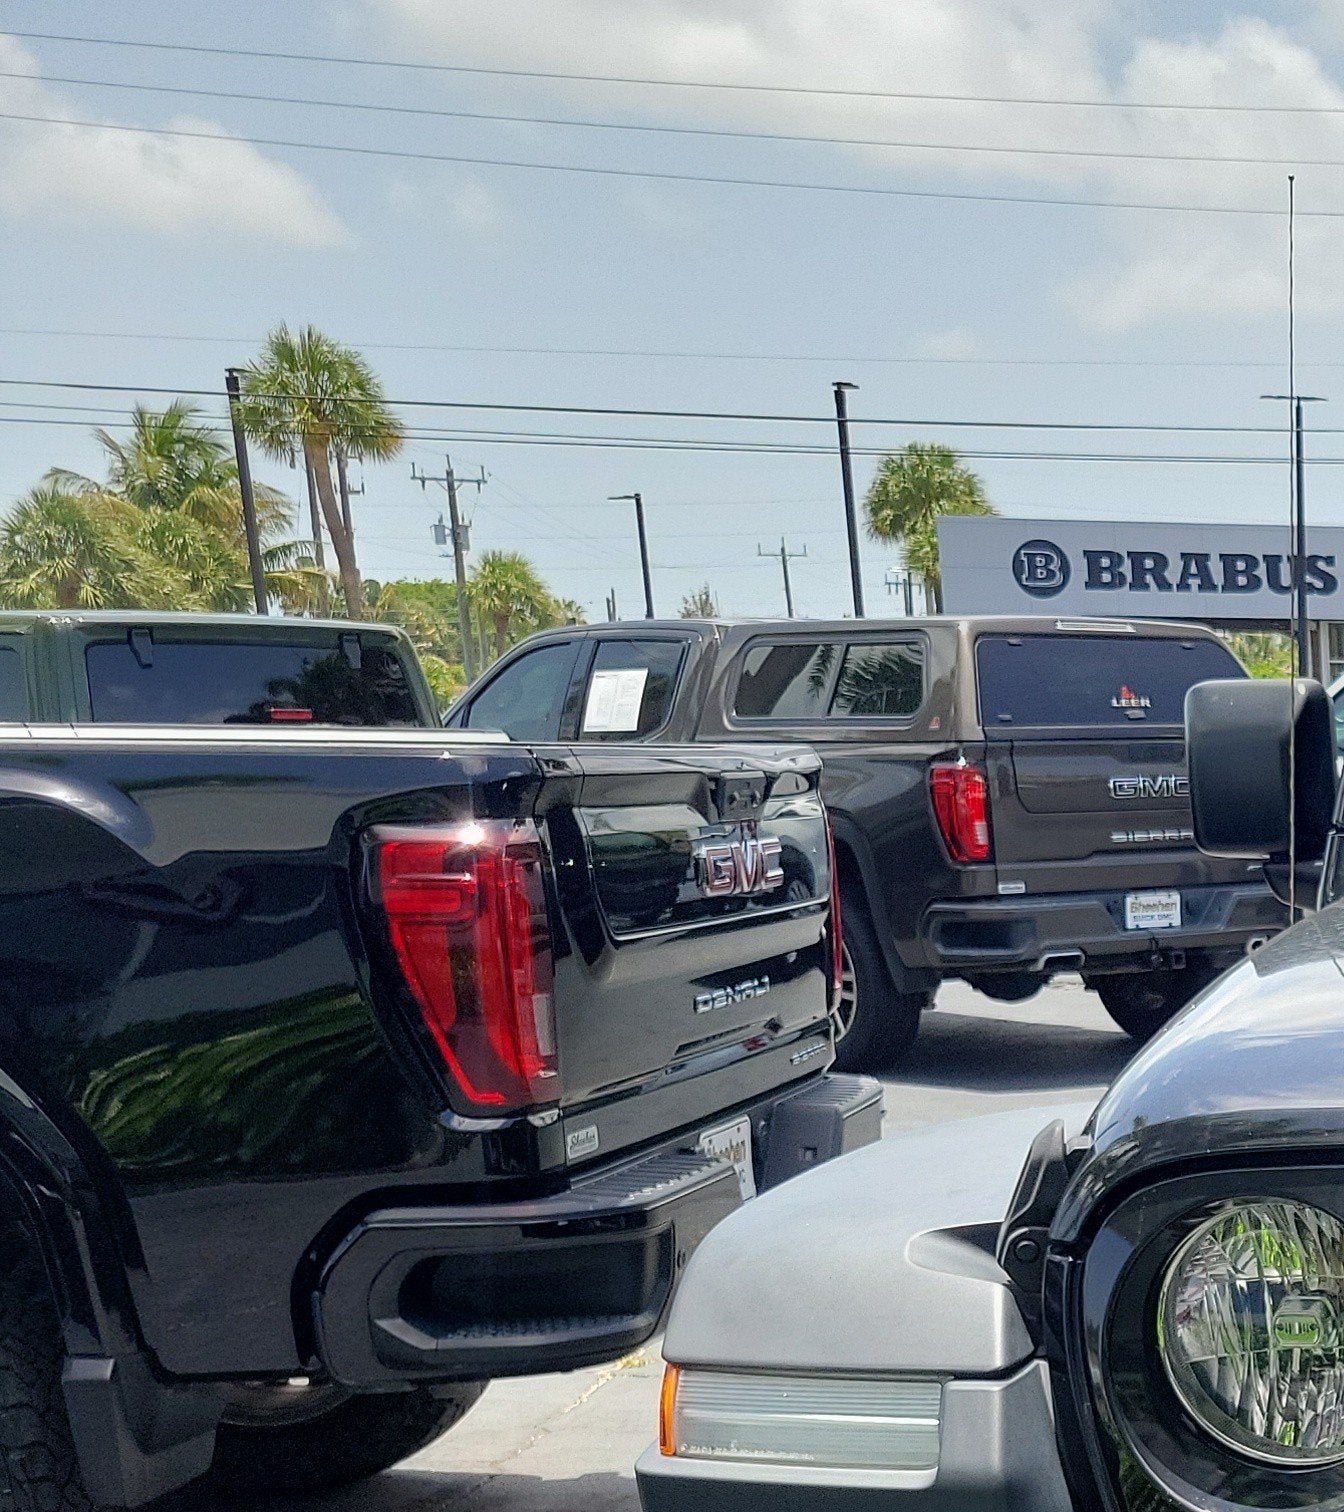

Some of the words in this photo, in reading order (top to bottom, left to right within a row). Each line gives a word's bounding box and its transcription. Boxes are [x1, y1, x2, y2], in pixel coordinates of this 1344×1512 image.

[1083, 549, 1340, 597] BRABUS
[1108, 773, 1190, 799] GMC
[699, 837, 785, 898] GMC
[693, 974, 771, 1014] DENALI
